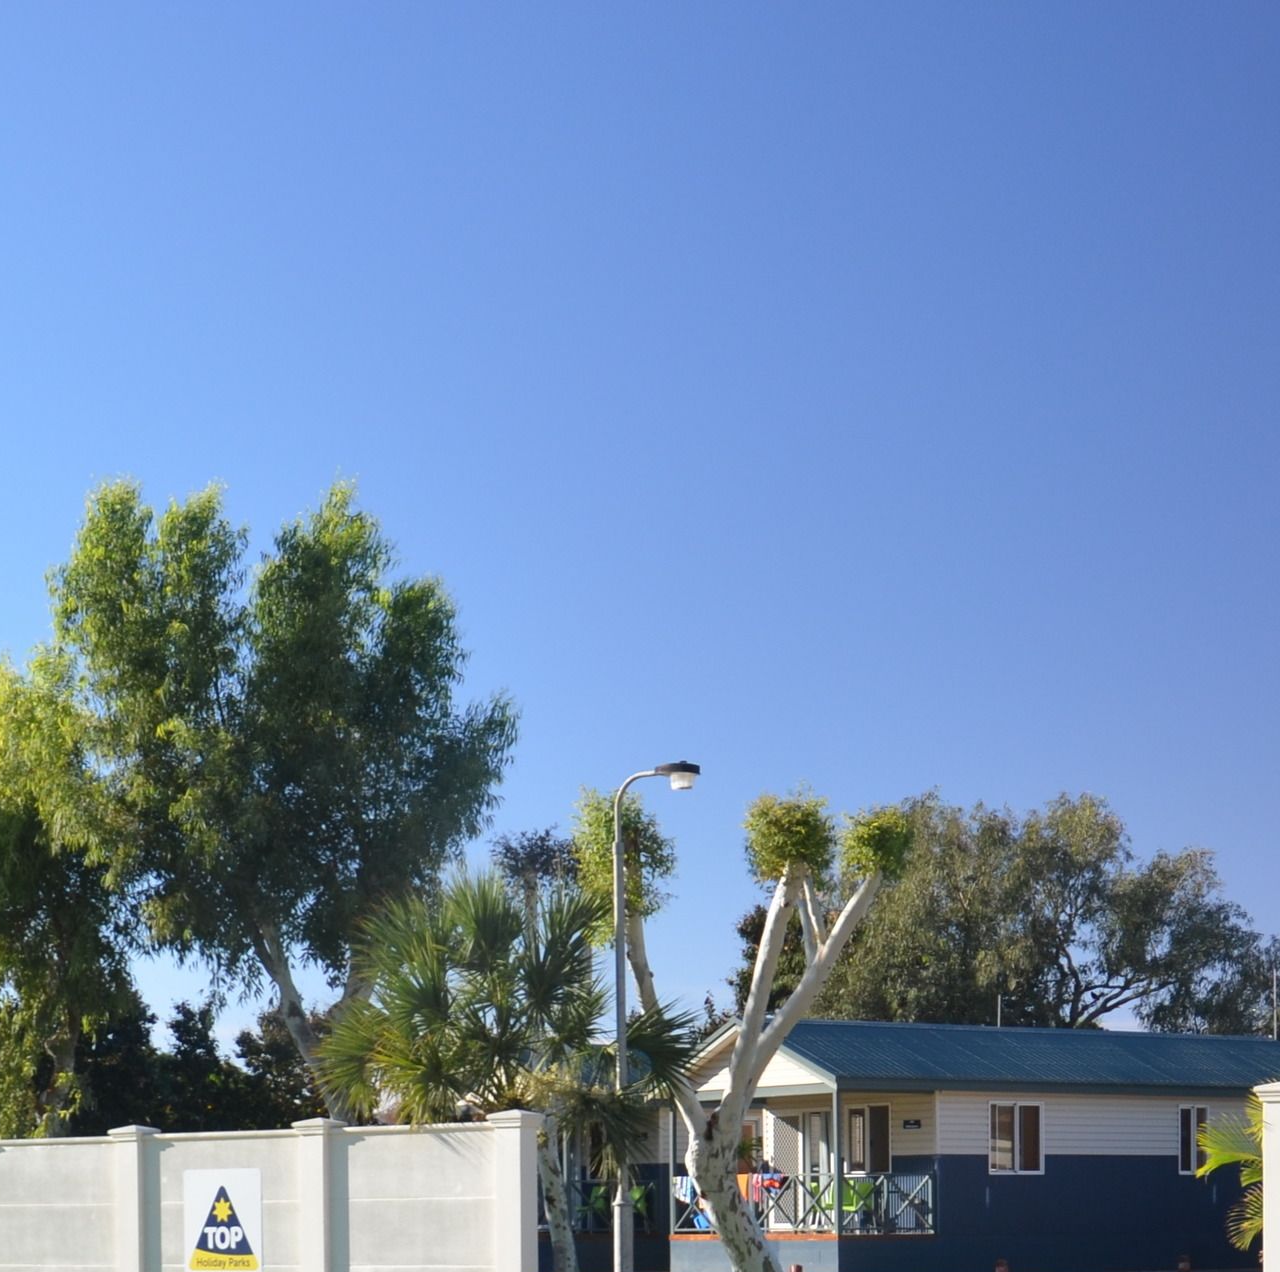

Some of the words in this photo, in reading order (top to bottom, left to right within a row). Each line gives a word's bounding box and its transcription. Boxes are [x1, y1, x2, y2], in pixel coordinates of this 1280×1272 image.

[204, 1225, 243, 1250] TOP
[196, 1258, 226, 1269] Holiday
[229, 1258, 251, 1267] Parks
